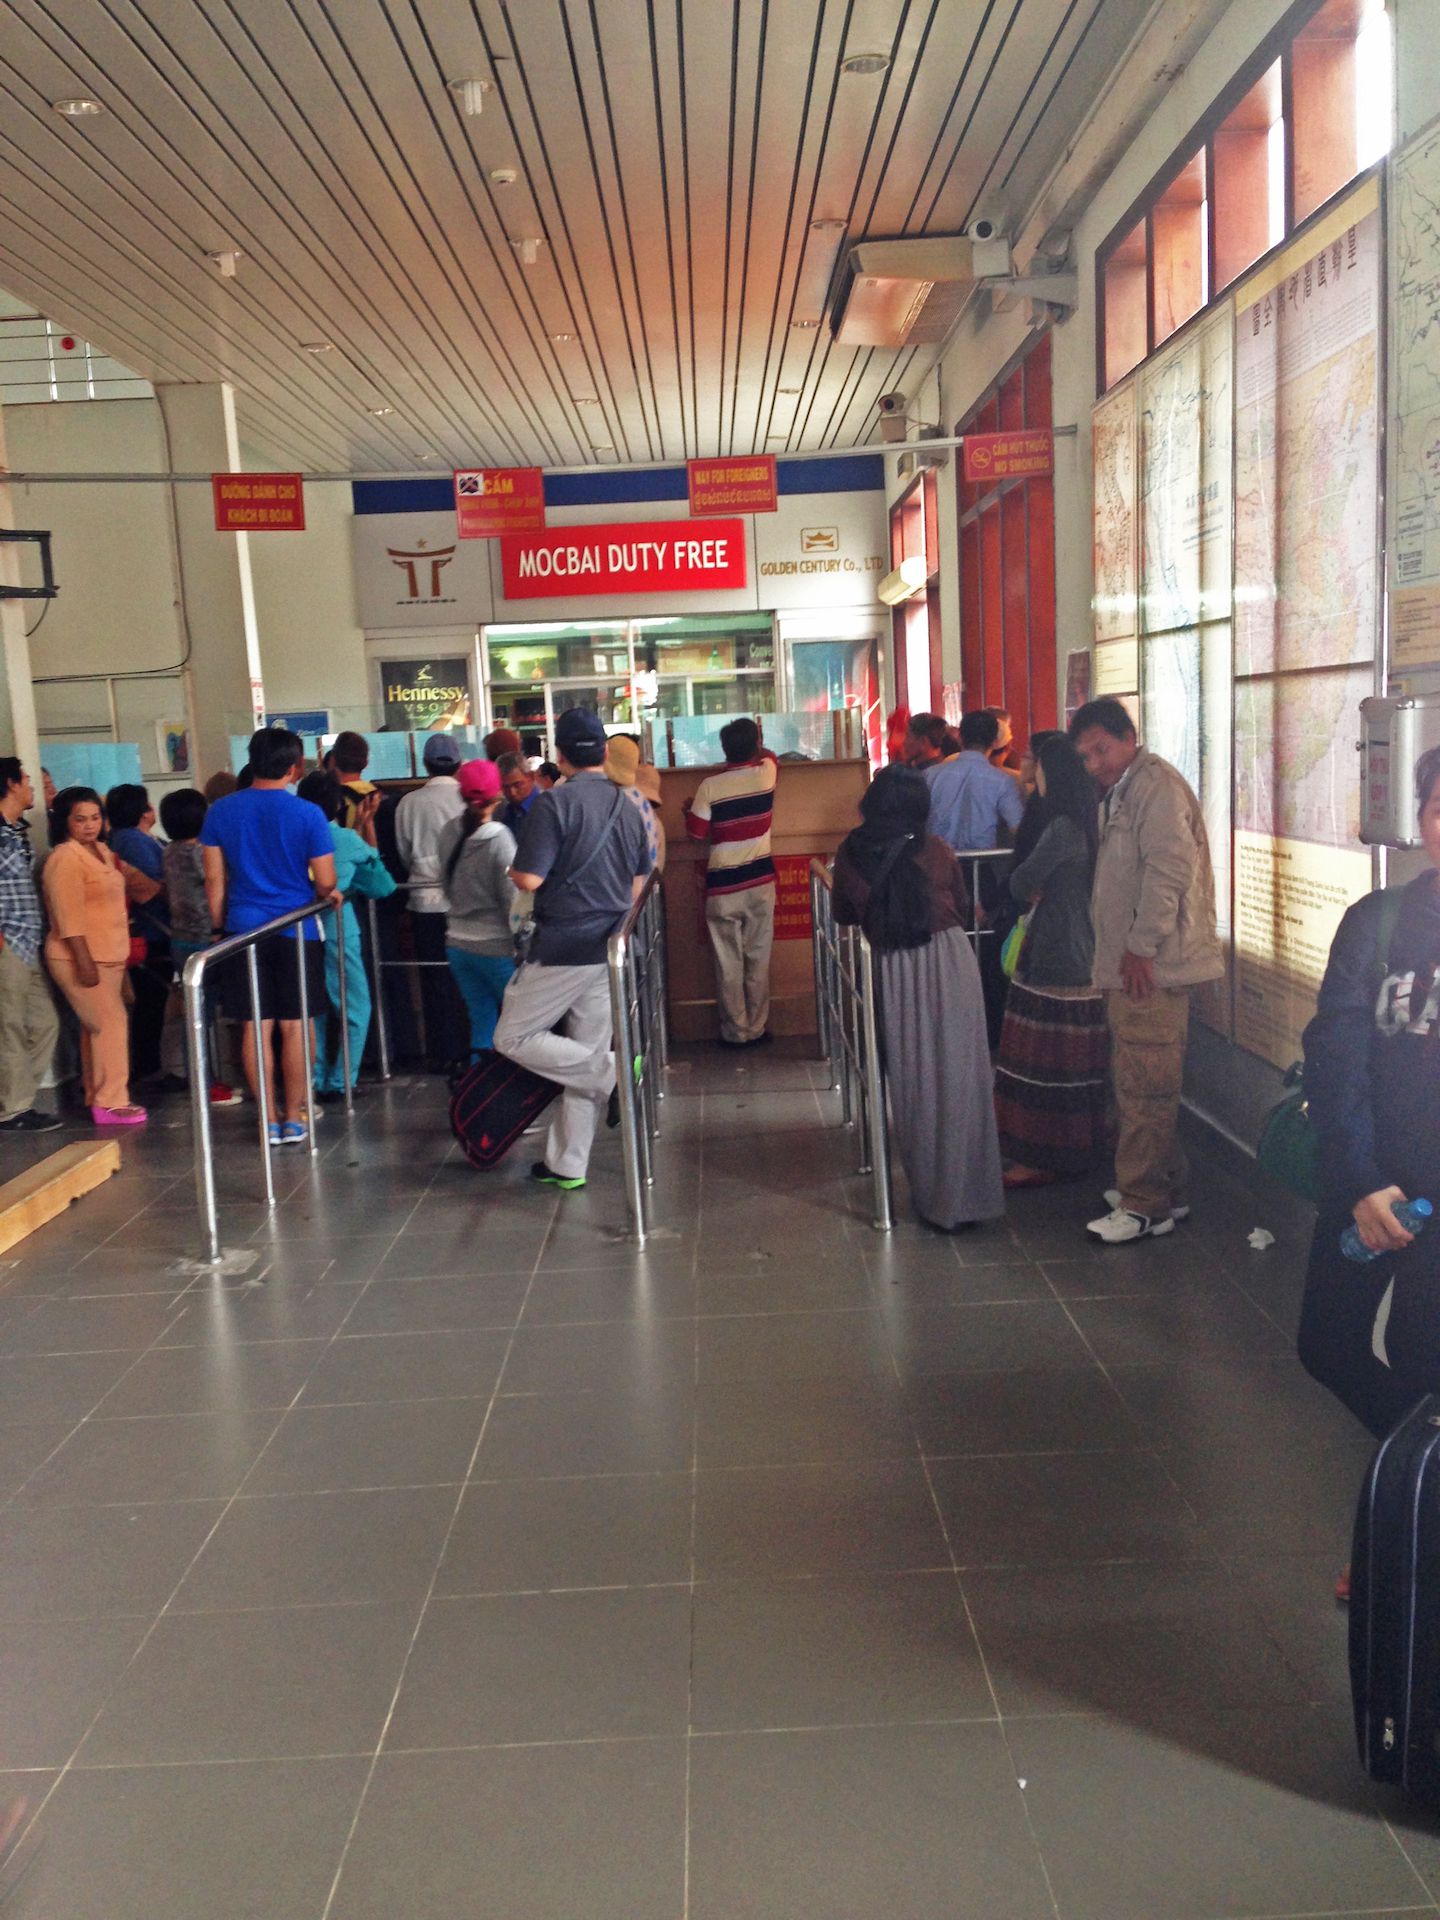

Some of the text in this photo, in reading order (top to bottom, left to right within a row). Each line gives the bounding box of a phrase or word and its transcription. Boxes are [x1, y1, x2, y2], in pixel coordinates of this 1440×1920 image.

[994, 457, 1049, 473] NO SMOKING
[483, 472, 514, 495] CẤM
[711, 469, 725, 484] FOR
[726, 466, 769, 483] FOREIGNERS
[278, 485, 296, 499] CHO
[519, 539, 729, 578] MOCBAI DUTY FREE
[760, 556, 884, 576] GOLDEN CENTURY Co., LTD
[387, 685, 465, 703] Hennessy
